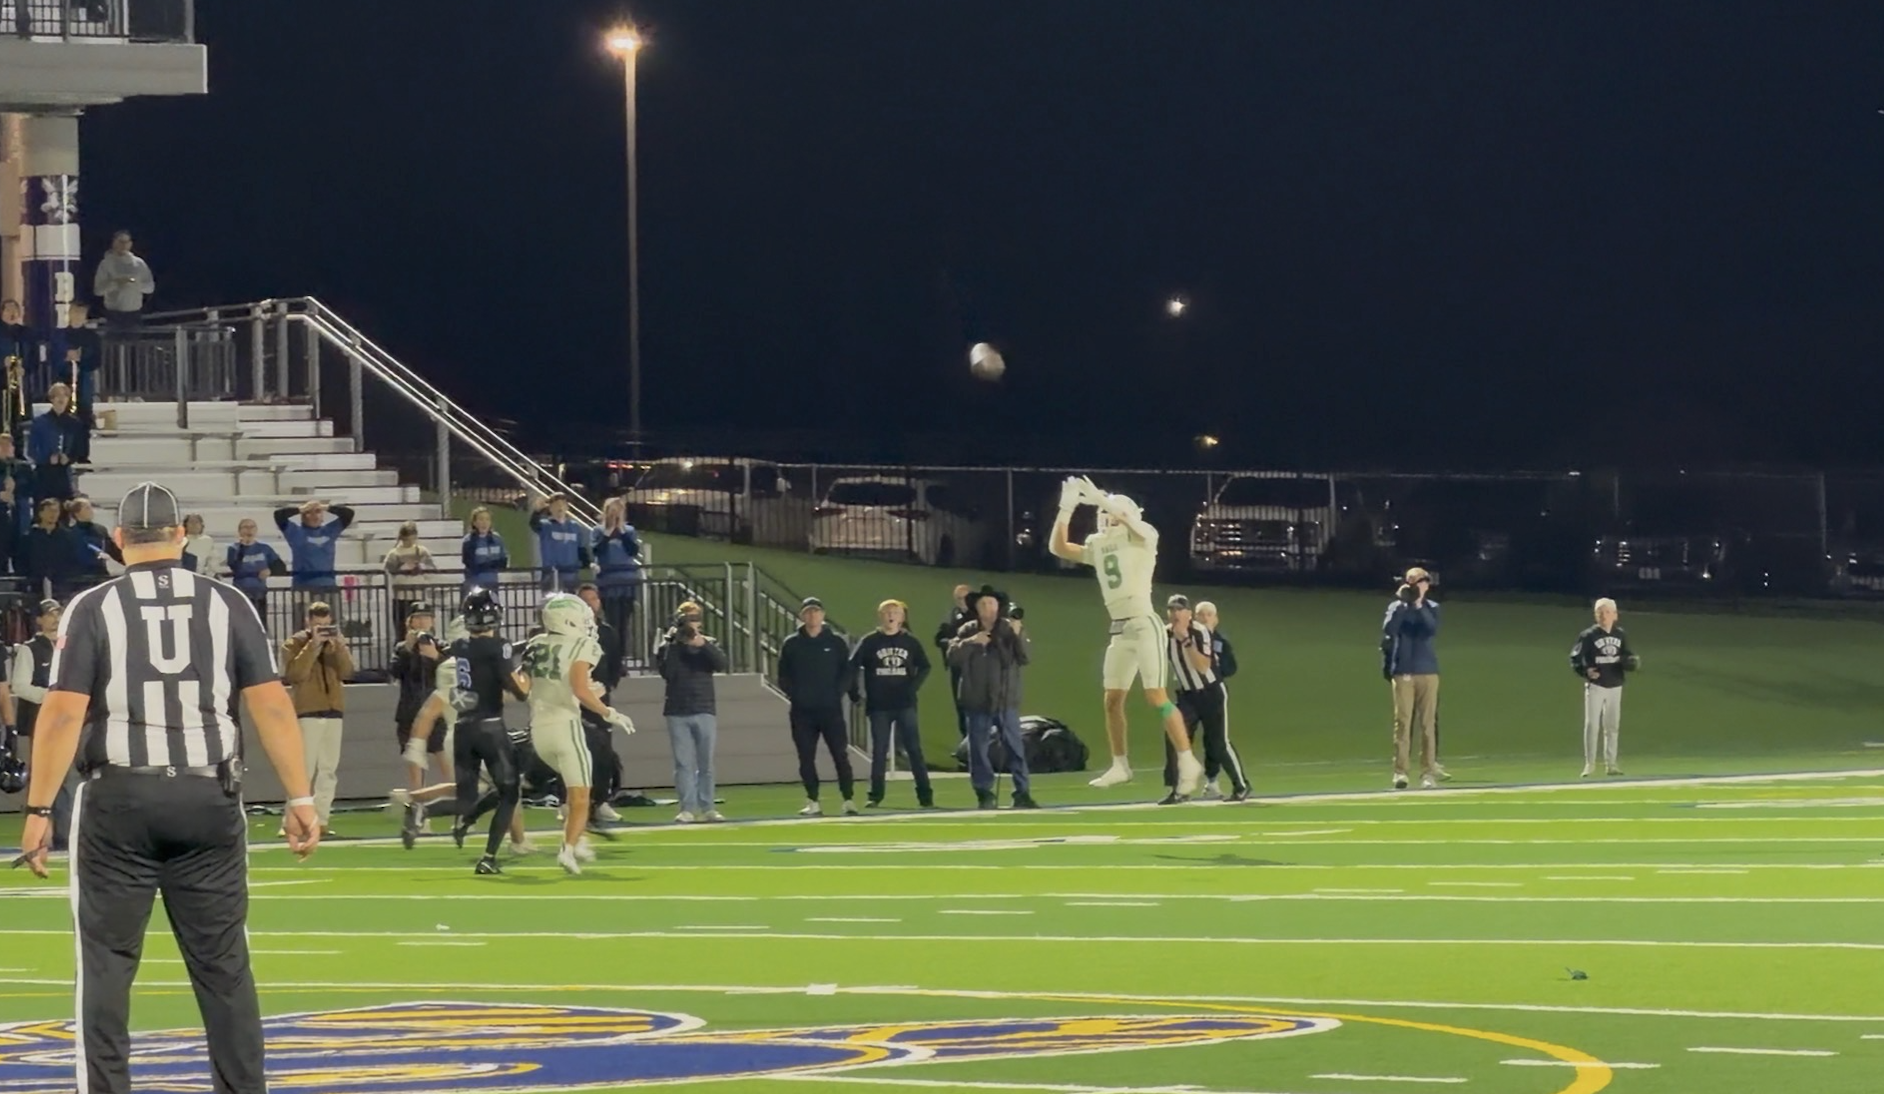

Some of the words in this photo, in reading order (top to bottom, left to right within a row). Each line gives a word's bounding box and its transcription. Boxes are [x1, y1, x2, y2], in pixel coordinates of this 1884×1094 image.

[158, 574, 169, 586] S
[1104, 554, 1122, 589] 9
[140, 604, 193, 674] U
[456, 657, 472, 689] 6
